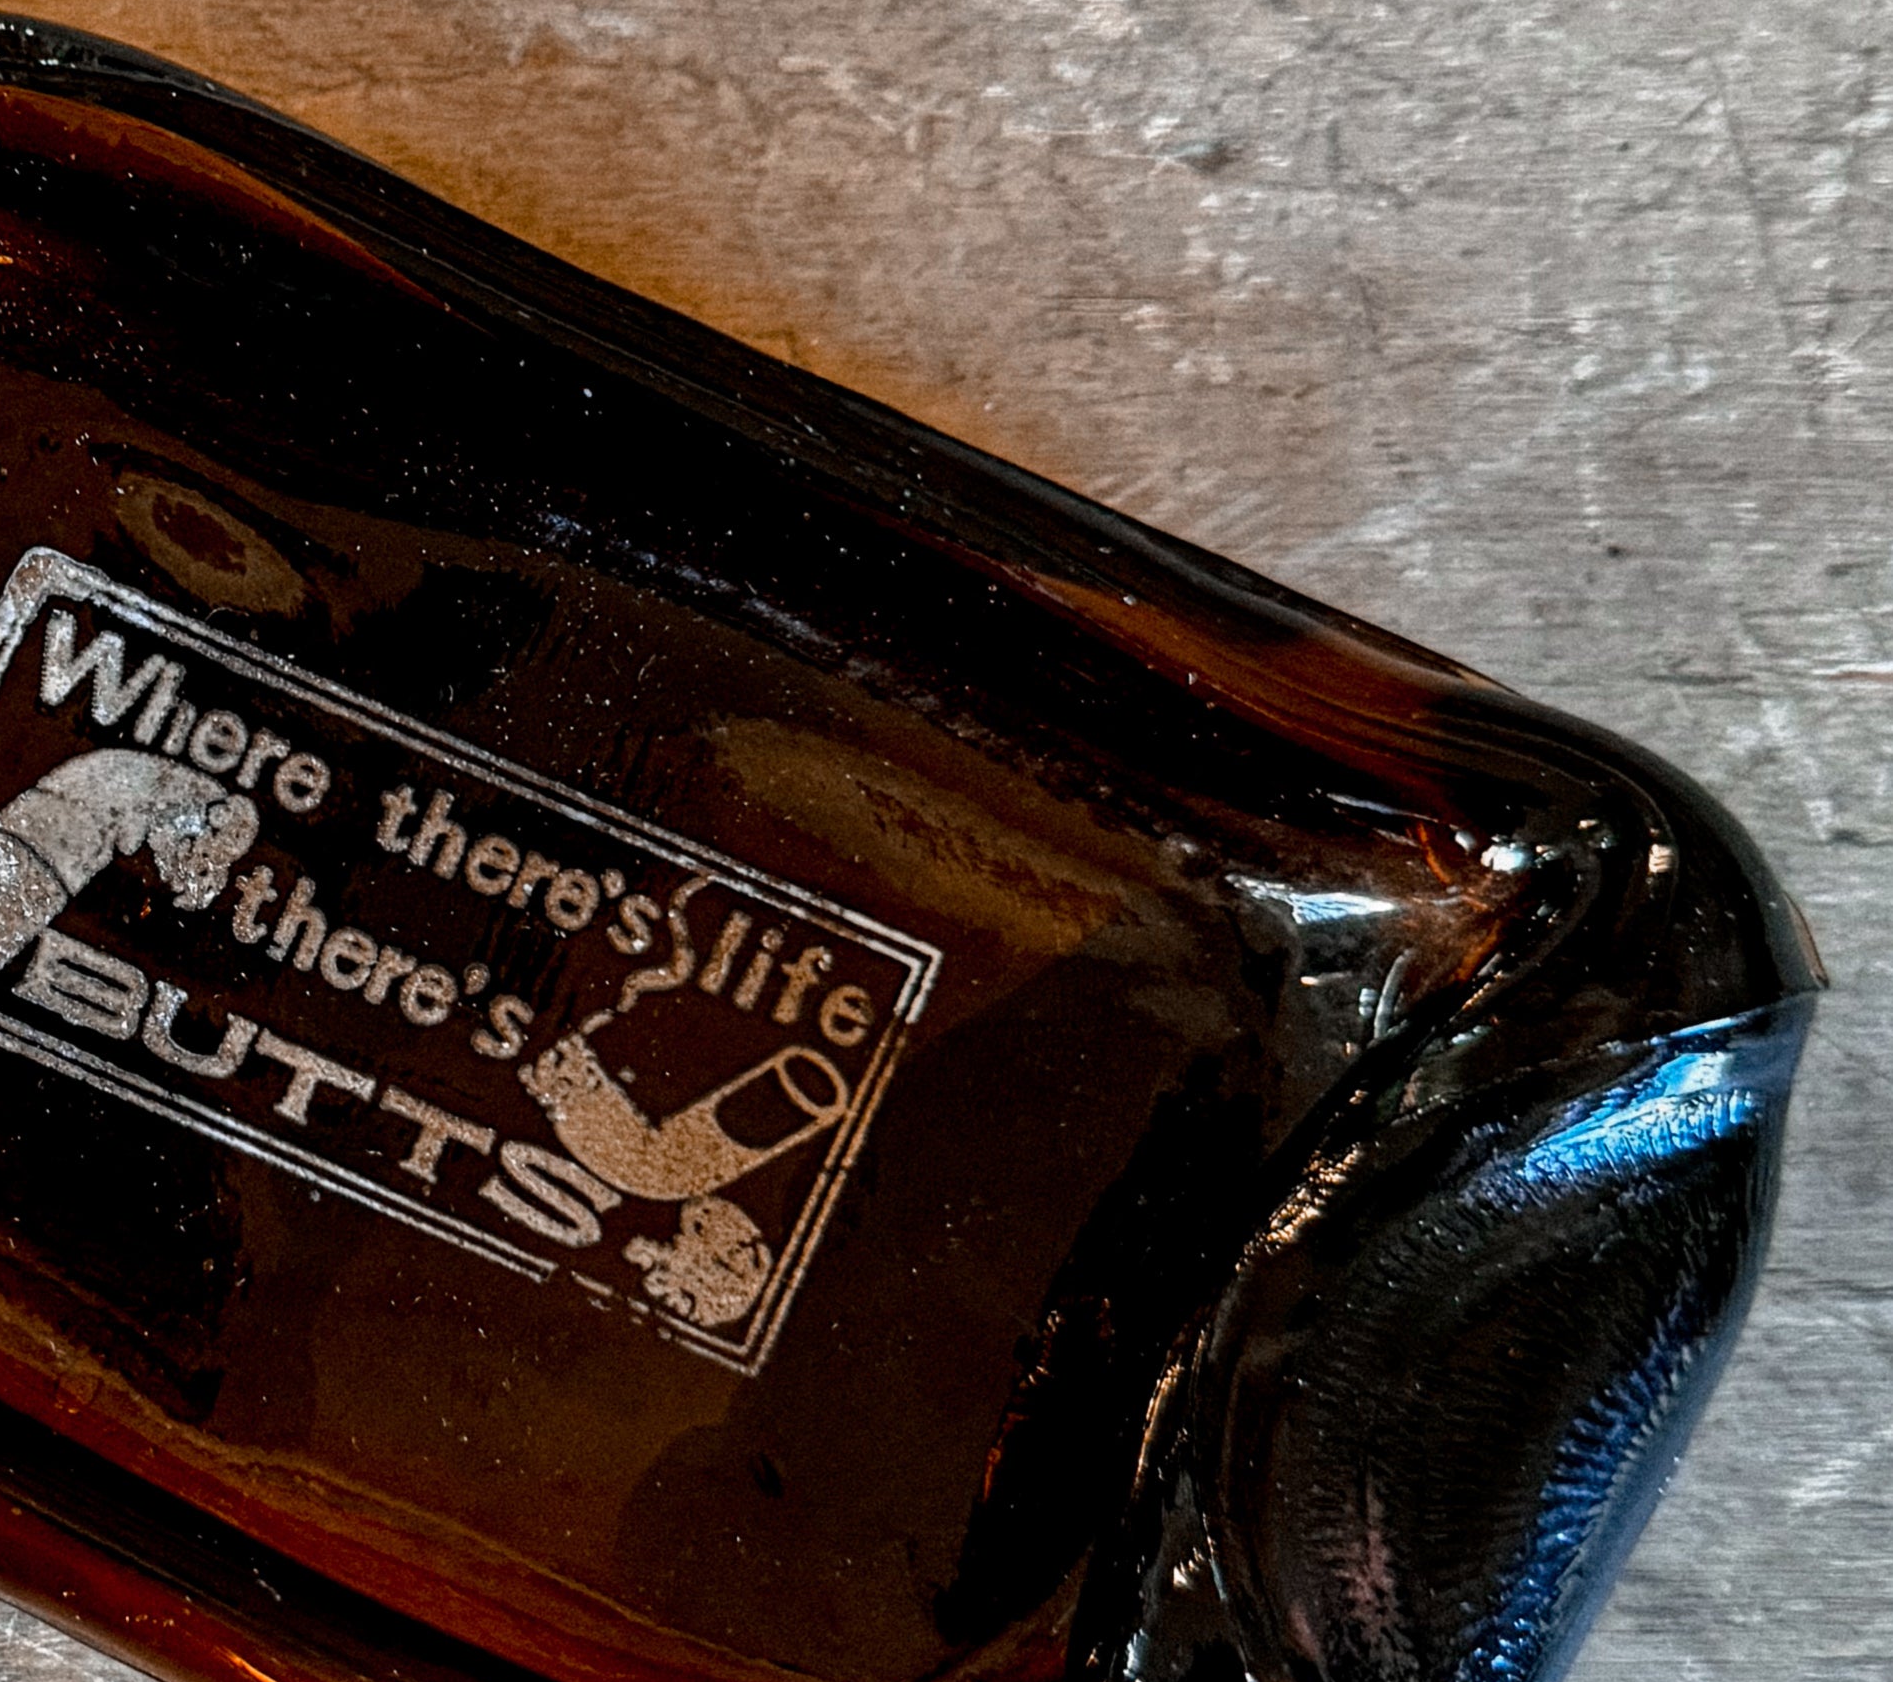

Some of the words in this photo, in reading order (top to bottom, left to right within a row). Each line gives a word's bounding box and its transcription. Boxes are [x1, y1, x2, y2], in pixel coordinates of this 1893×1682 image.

[38, 609, 330, 812] Where
[375, 784, 658, 954] there's
[698, 913, 874, 1045] life
[231, 865, 534, 1057] there's
[12, 928, 620, 1246] BUTTS
